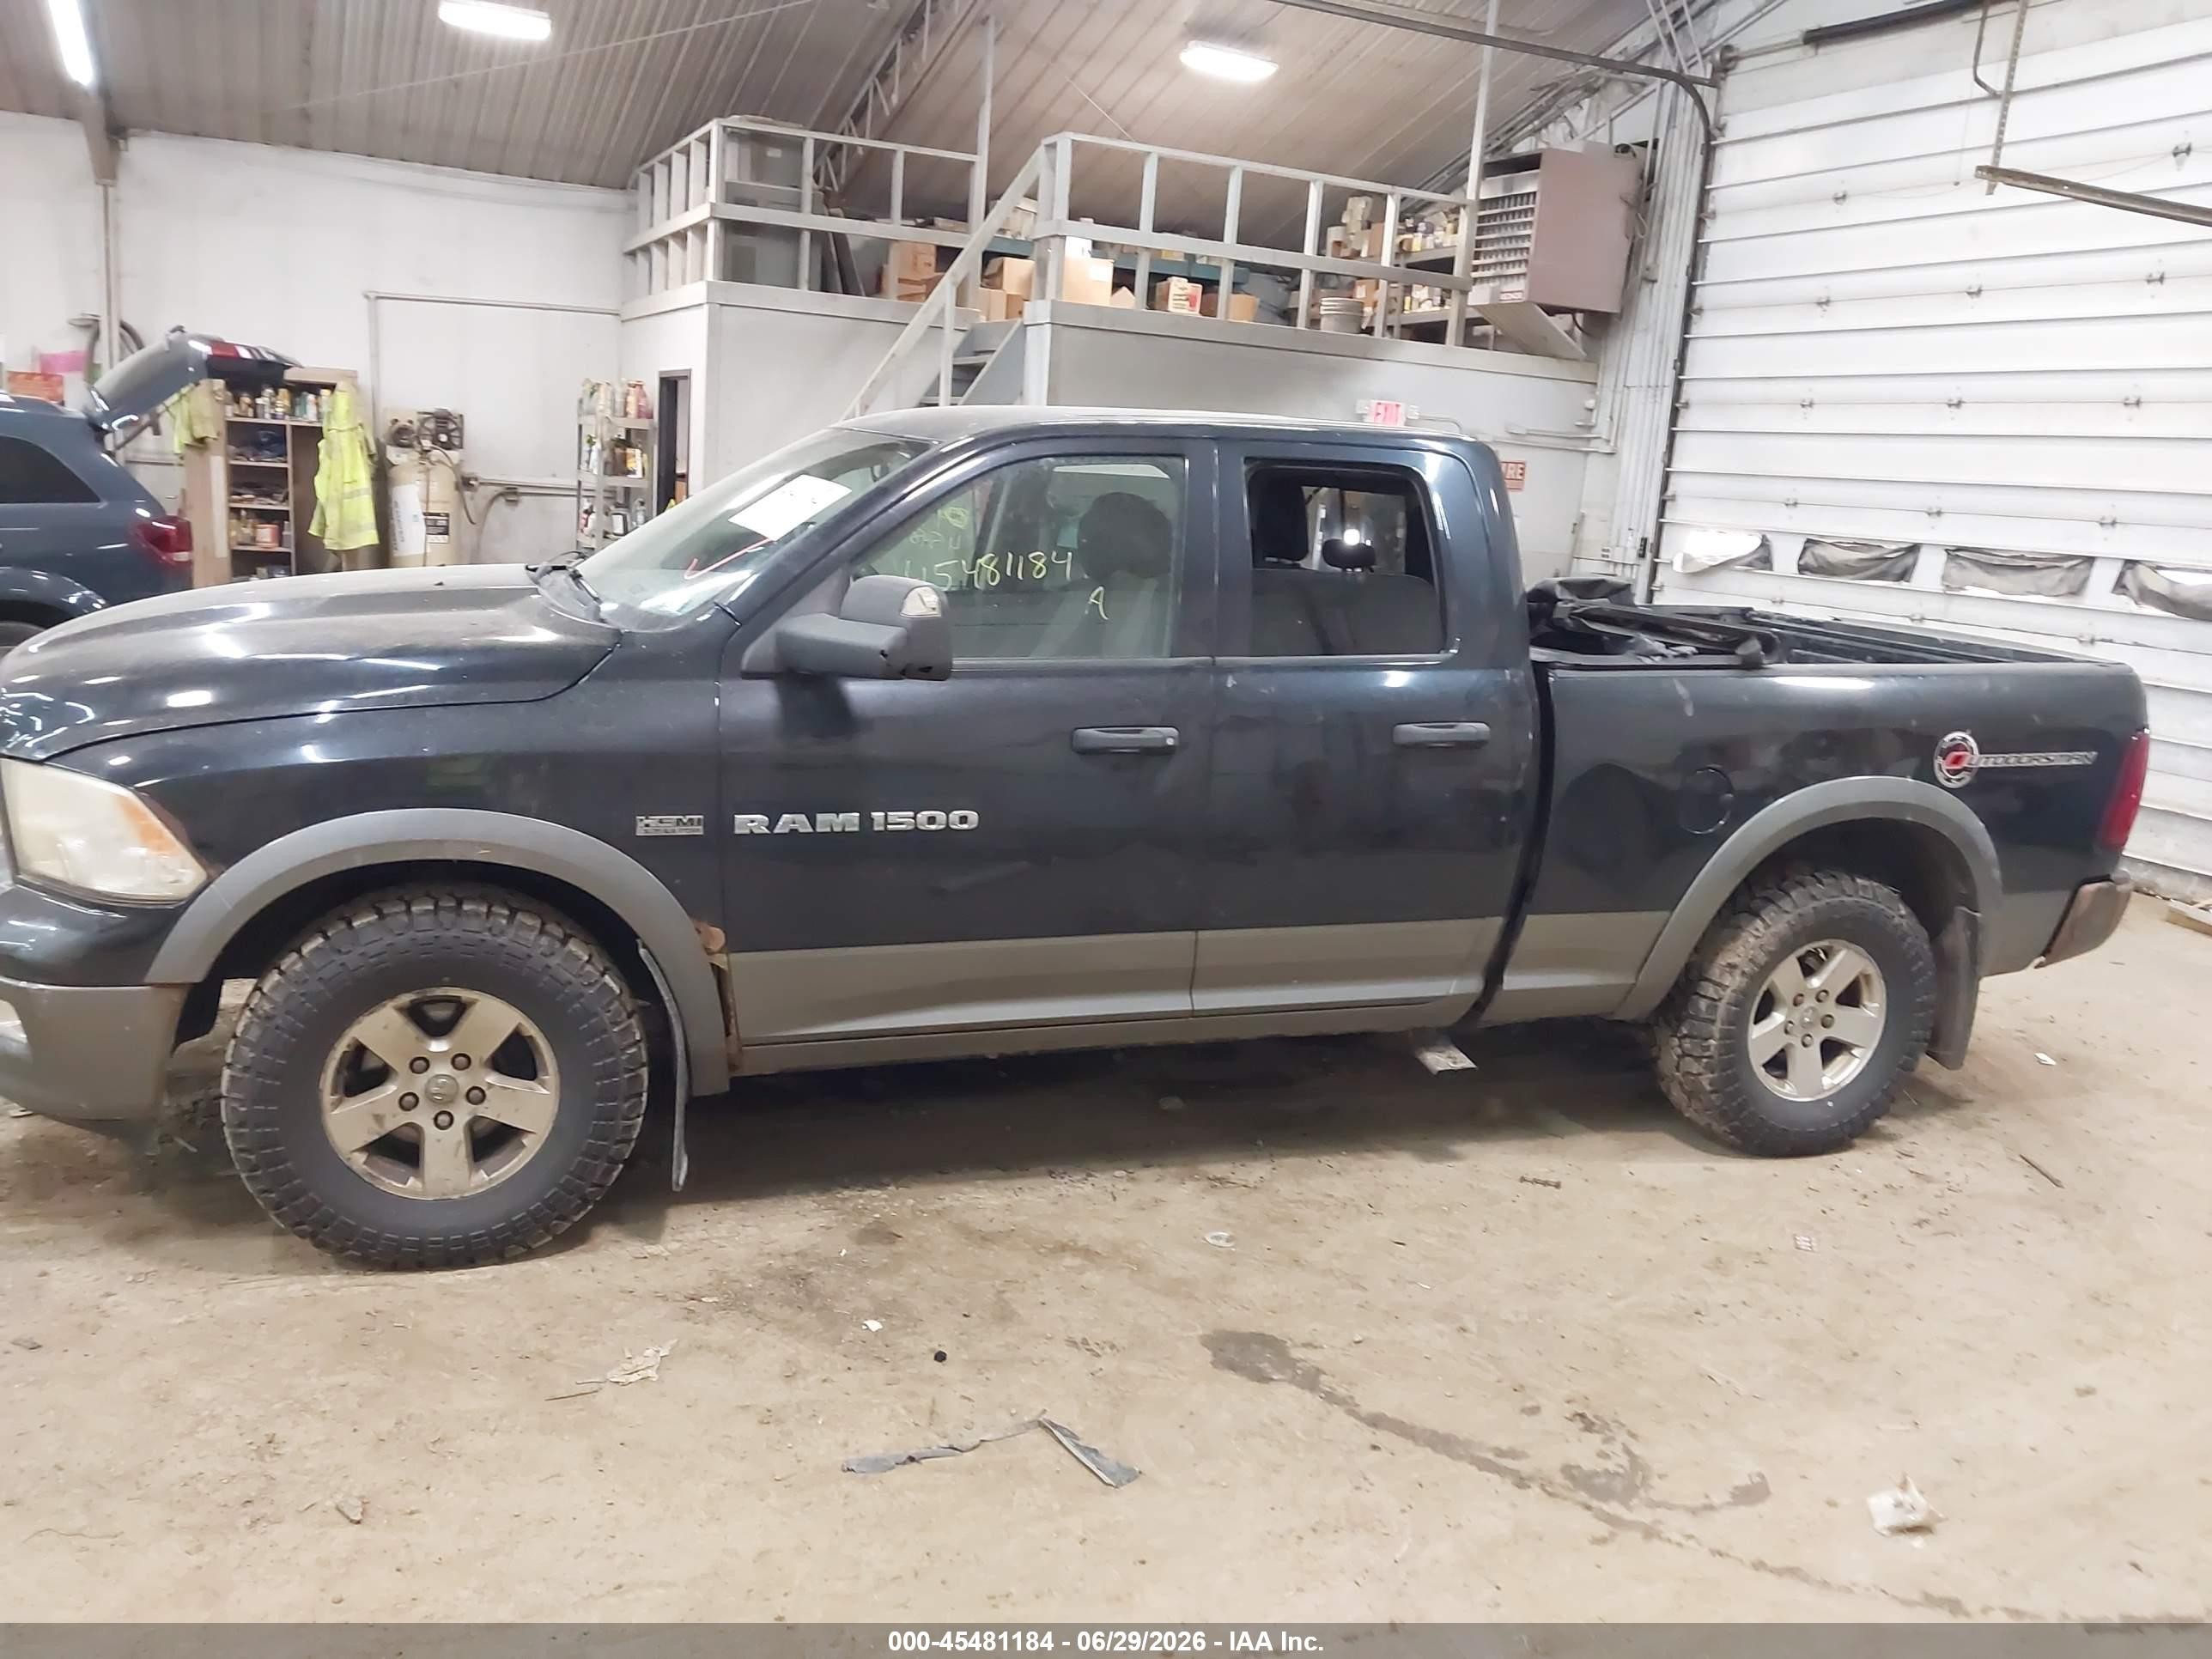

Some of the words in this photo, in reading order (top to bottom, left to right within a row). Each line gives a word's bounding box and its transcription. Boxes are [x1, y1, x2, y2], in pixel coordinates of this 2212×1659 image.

[1085, 586, 1109, 620] A
[733, 813, 860, 835] RAM
[871, 810, 980, 832] 1500
